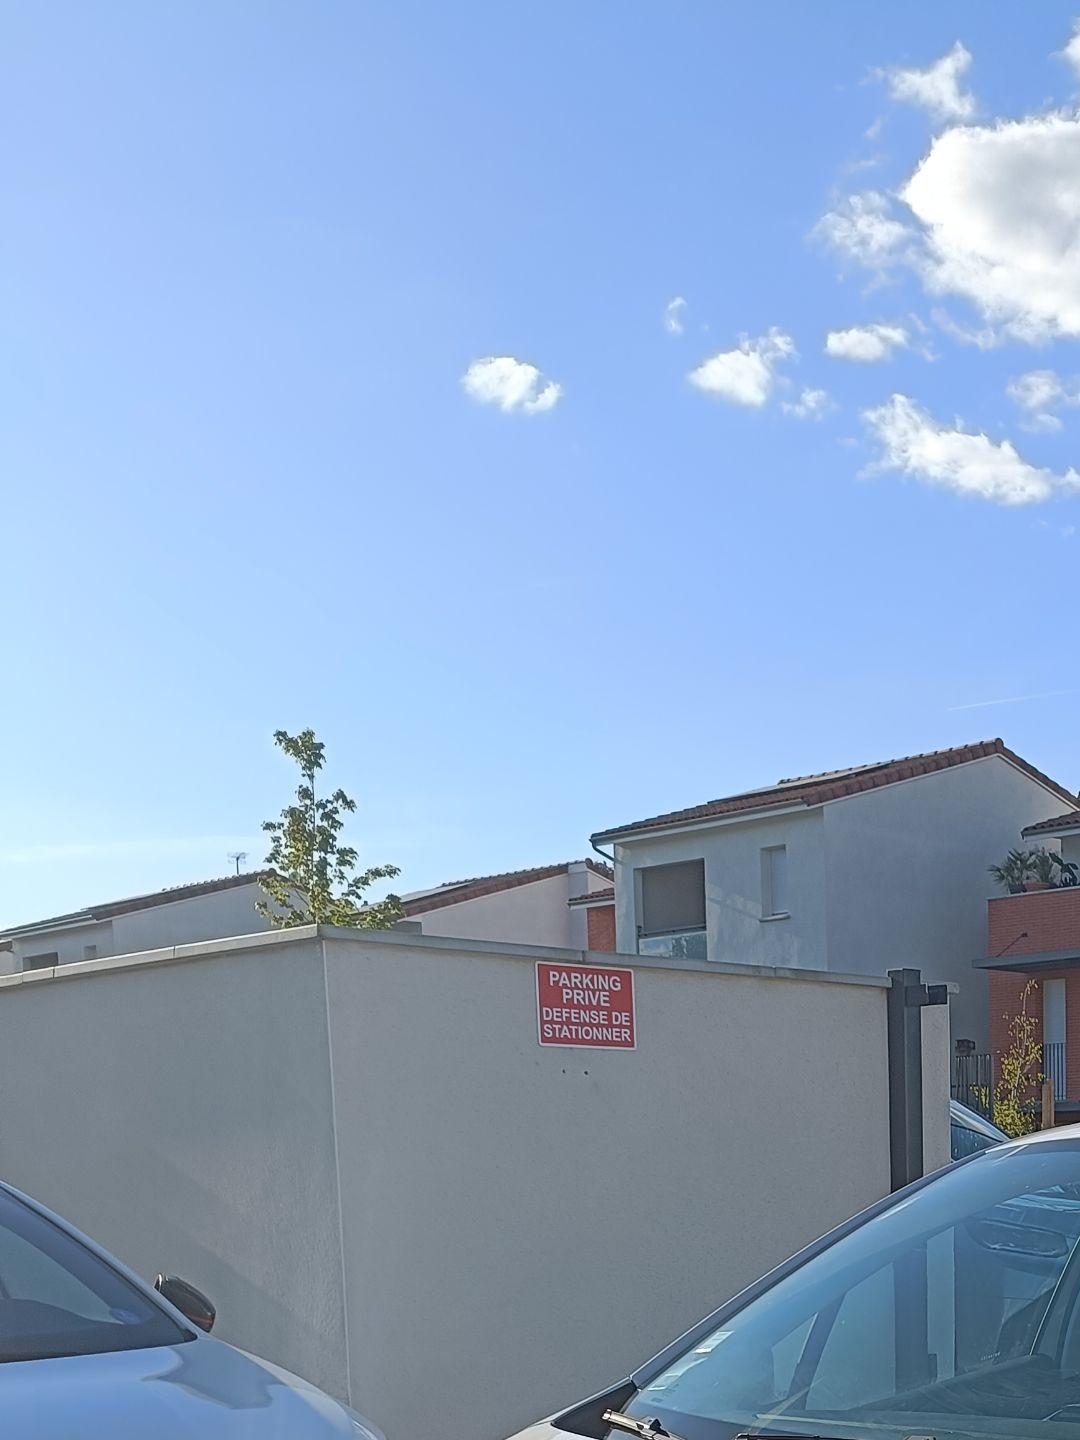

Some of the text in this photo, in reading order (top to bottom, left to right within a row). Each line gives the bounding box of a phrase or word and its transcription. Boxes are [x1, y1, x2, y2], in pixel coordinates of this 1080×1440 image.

[549, 970, 622, 991] PARKING
[562, 988, 610, 1007] PRIVE
[543, 1007, 631, 1026] DEFENSE DE
[543, 1023, 632, 1042] STATIONNER
